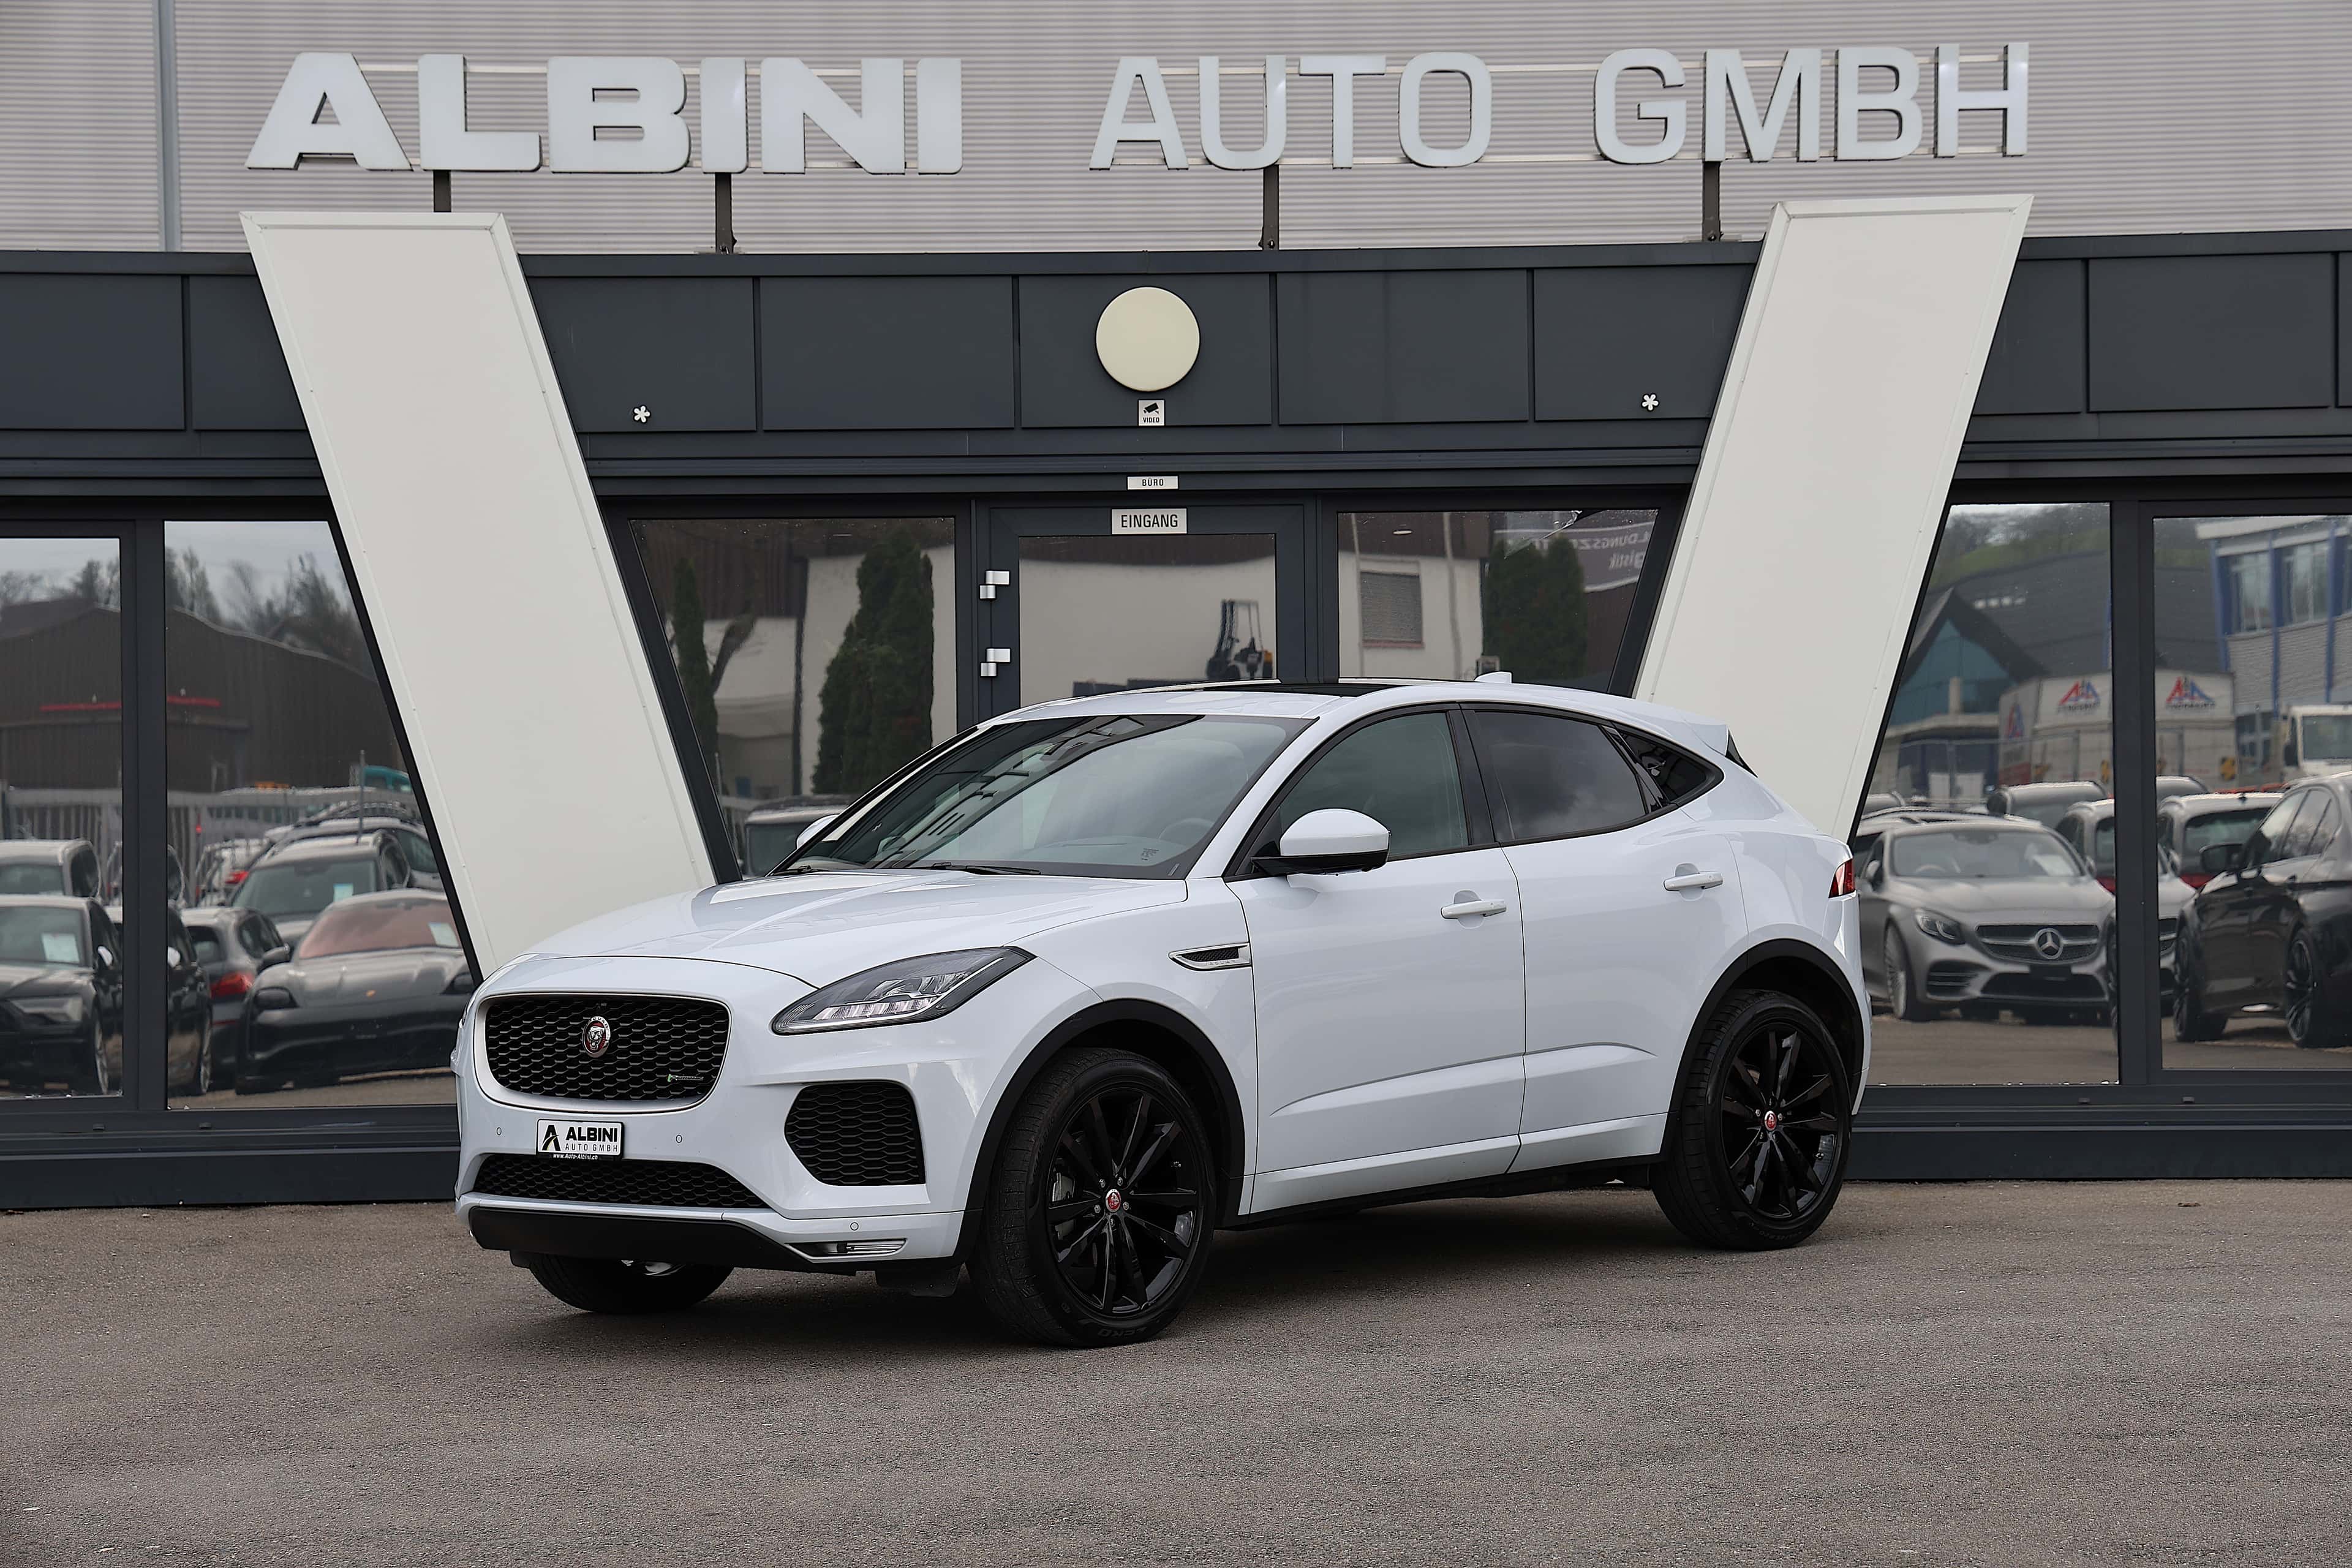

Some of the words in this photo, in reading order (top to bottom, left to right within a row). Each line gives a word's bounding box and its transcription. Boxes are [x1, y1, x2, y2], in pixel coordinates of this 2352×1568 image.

[246, 51, 963, 176] ALBINI
[1088, 51, 1492, 172] AUTO
[1593, 42, 2029, 165] GMBH
[1142, 477, 1164, 486] BÜRO
[1121, 514, 1178, 528] EINGANG
[565, 1126, 618, 1142] ALBINI
[565, 1143, 588, 1152] AUTO
[592, 1144, 617, 1152] GMBH
